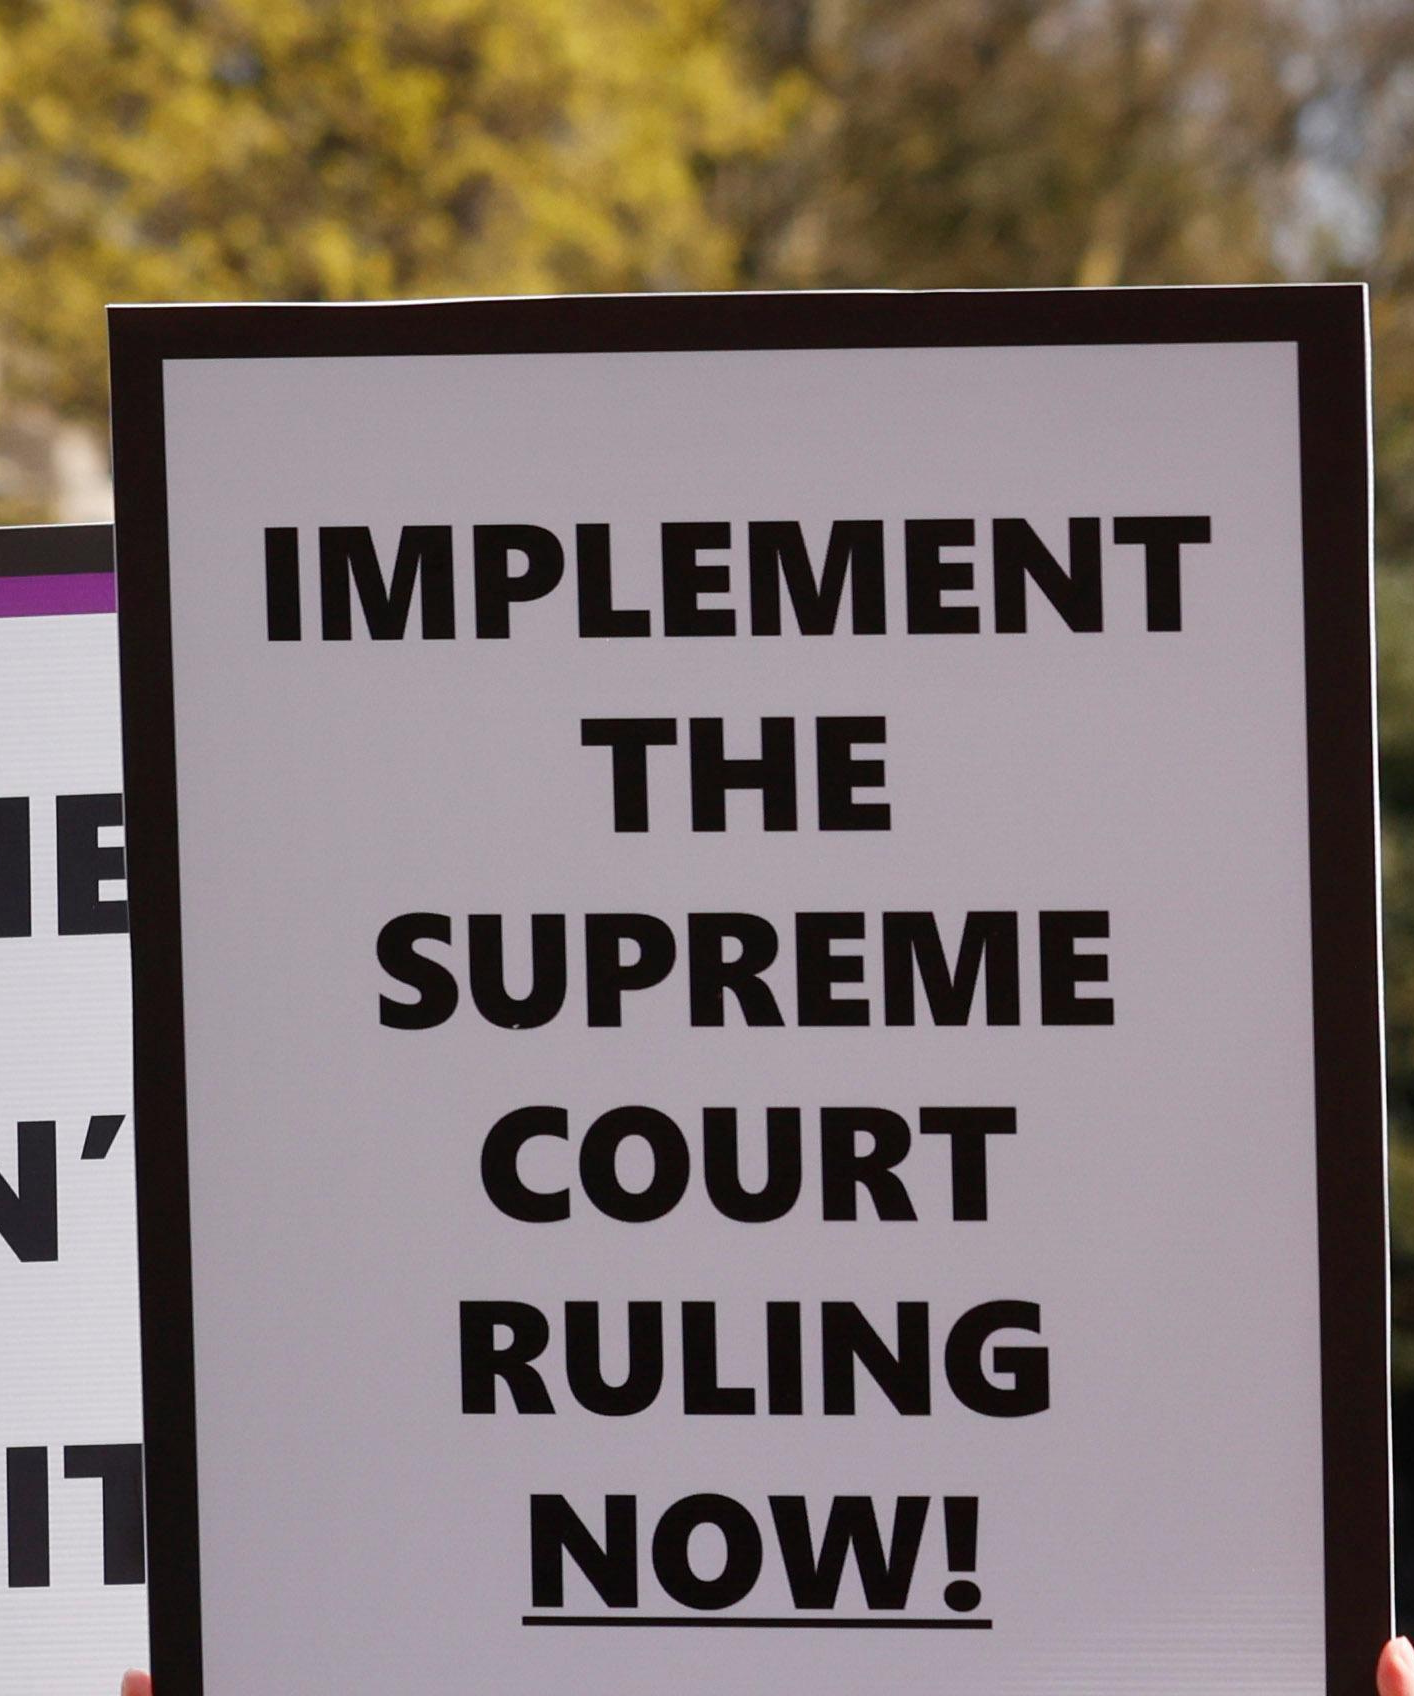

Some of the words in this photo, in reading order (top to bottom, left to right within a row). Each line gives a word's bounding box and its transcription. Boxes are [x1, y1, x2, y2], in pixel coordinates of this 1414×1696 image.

[265, 516, 1211, 641] IMPLEMENT
[581, 716, 891, 832] THE
[377, 911, 1114, 1030] SUPREME
[481, 1106, 1016, 1223] COURT
[460, 1300, 1049, 1418] RULING
[530, 1493, 983, 1612] NOW!
